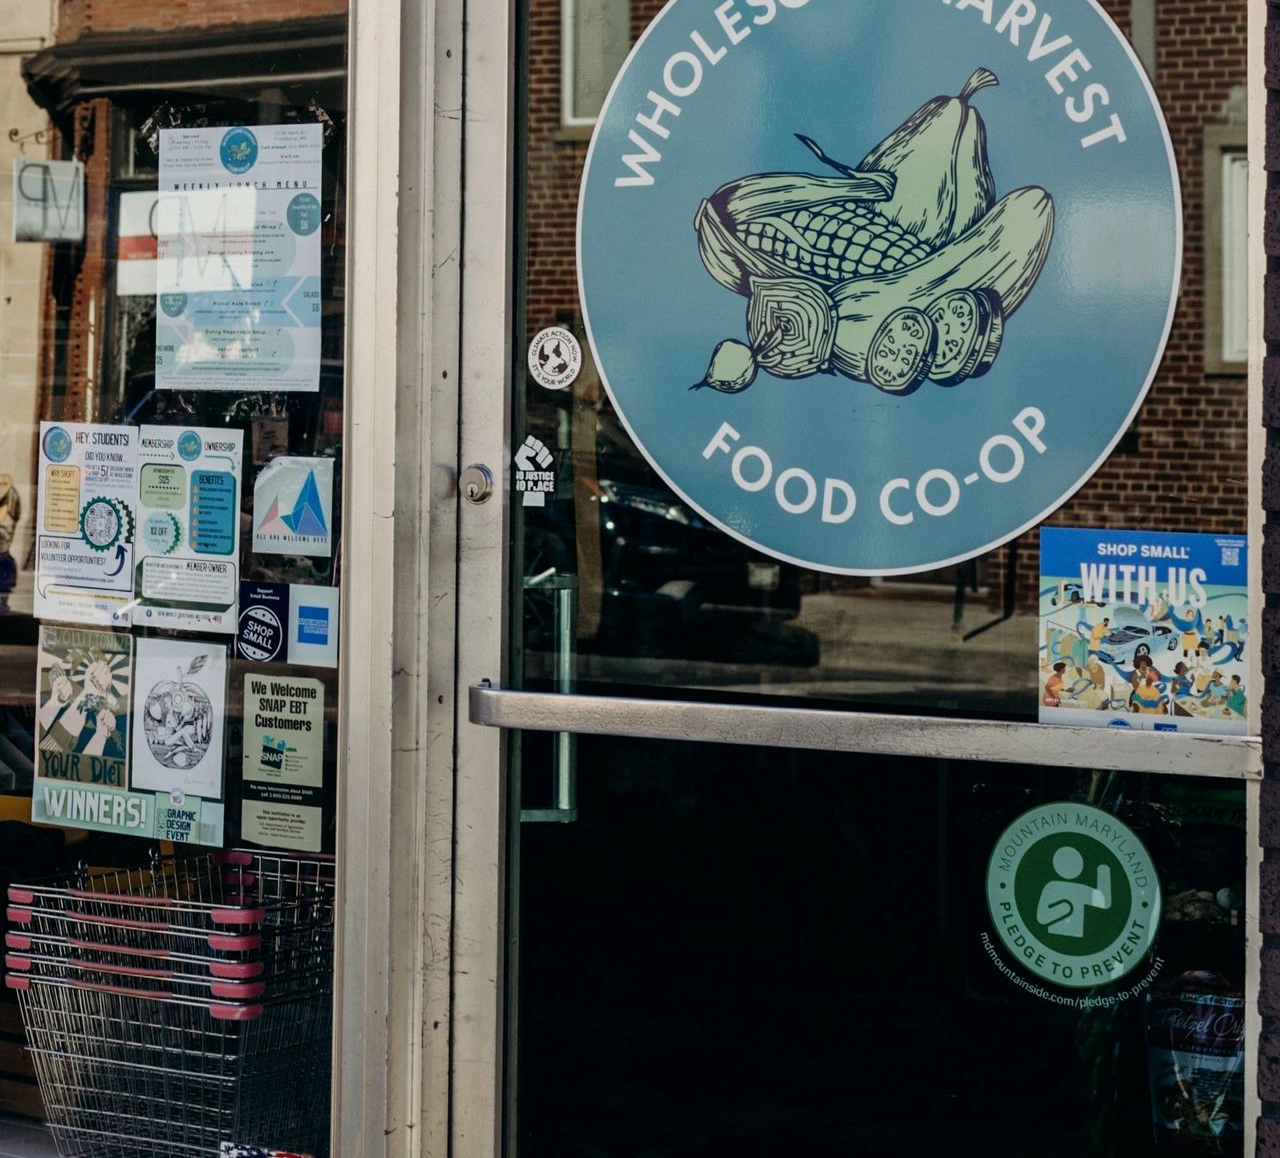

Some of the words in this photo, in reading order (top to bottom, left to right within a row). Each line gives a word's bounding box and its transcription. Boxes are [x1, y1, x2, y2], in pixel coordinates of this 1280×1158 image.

[174, 182, 219, 191] WEEKLY
[532, 331, 549, 356] CLIMATE
[550, 330, 572, 345] ACTION
[570, 345, 578, 363] NOW
[541, 376, 556, 386] YOUR
[557, 369, 576, 385] WORLD
[92, 433, 129, 447] STUDENTS!
[141, 438, 174, 449] MEMBERSHIP
[204, 442, 236, 451] OWNERSHIP
[85, 451, 94, 461] DID
[95, 452, 105, 462] YOU
[702, 421, 856, 523] FOOD
[879, 405, 1047, 525] CO-OP
[199, 474, 224, 485] BENEFITS
[525, 471, 554, 481] JUSTICE
[41, 540, 60, 549] LOOKING
[61, 542, 70, 550] FOR
[1097, 543, 1137, 557] SHOP
[1140, 546, 1189, 559] SMALL
[41, 553, 67, 562] VOLUNTEER
[68, 555, 106, 565] OPPORTUNITIES?
[1080, 563, 1156, 605] WITH
[1167, 567, 1207, 608] US
[247, 620, 274, 637] SHOP
[243, 630, 273, 651] SMALL
[251, 681, 266, 695] We
[270, 682, 316, 699] Welcome
[259, 698, 286, 712] SNAP
[290, 701, 308, 715] EBT
[255, 714, 312, 731] Customers
[261, 752, 283, 762] SNAP
[41, 751, 82, 781] YOUR
[43, 786, 147, 828] WINNERS!
[167, 808, 196, 821] GRAPHIC
[166, 819, 191, 832] DESIGN
[166, 830, 190, 842] EVENT
[999, 812, 1068, 872] MOUNTAIN
[1075, 814, 1148, 888] MARYLAND
[999, 902, 1046, 968] PLEDGE
[1052, 962, 1073, 978] TO
[1080, 920, 1145, 979] PREVENT
[980, 932, 1165, 1009] mdmountainside.com/pledge-to-prevent
